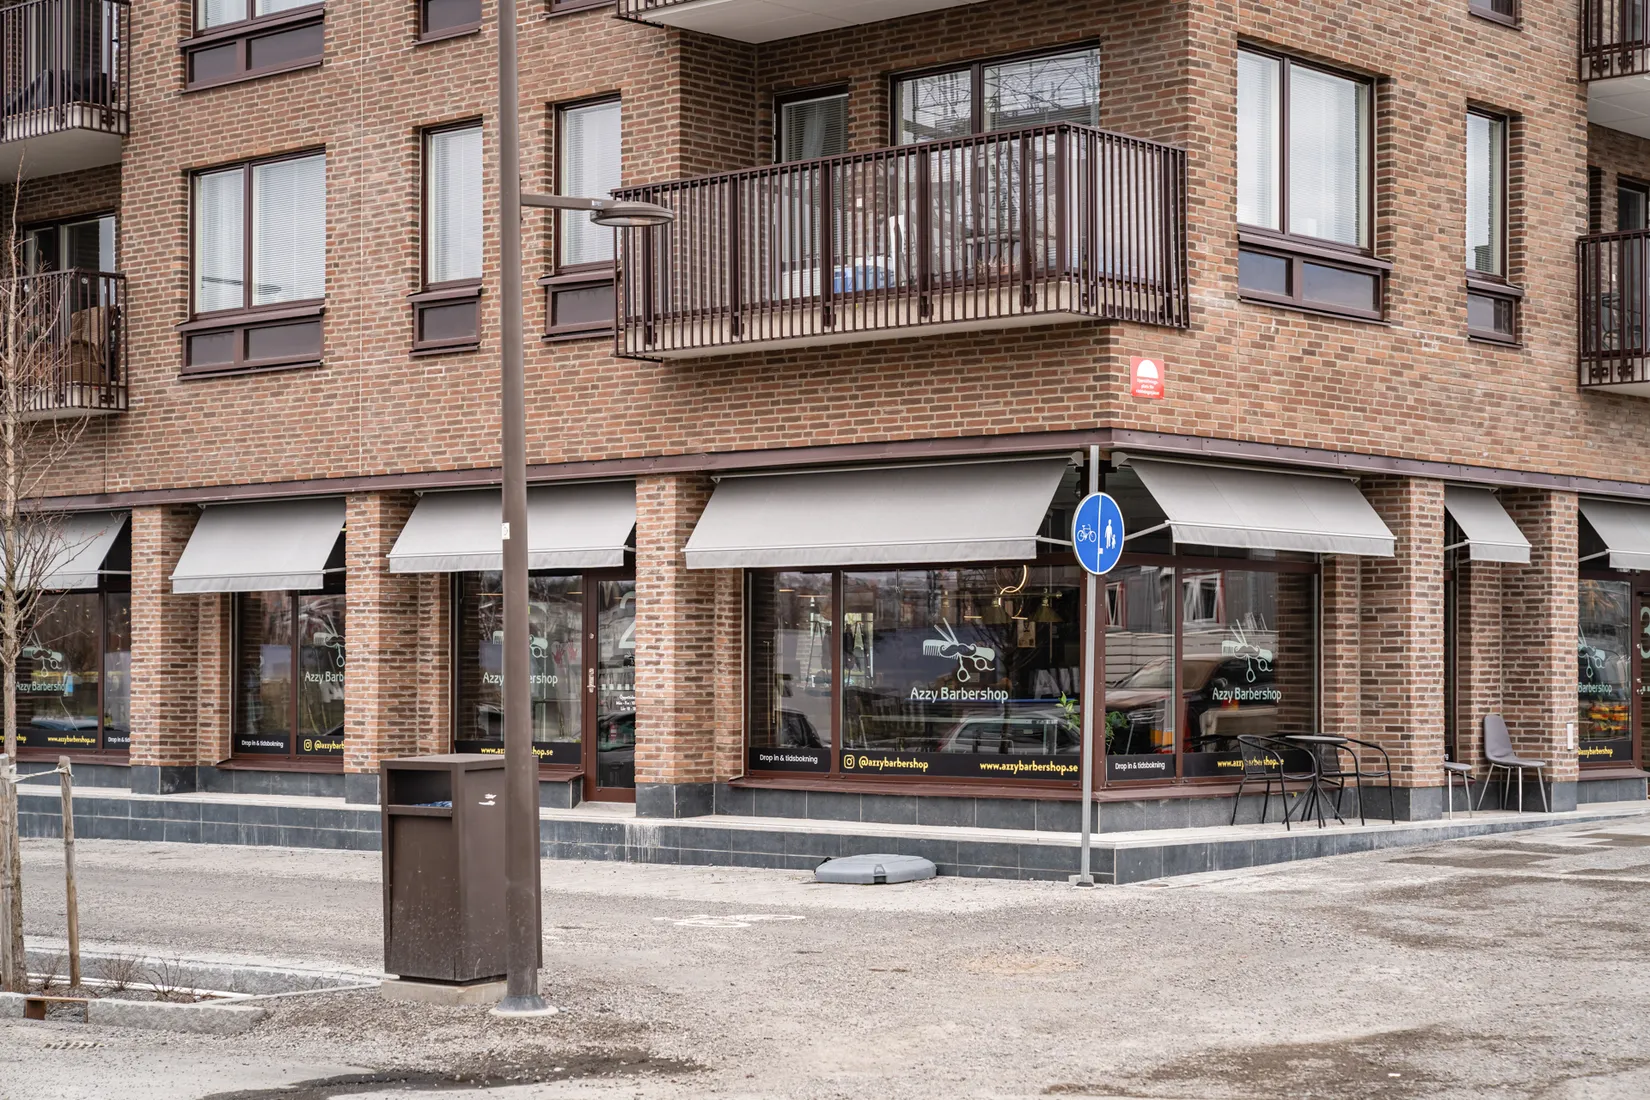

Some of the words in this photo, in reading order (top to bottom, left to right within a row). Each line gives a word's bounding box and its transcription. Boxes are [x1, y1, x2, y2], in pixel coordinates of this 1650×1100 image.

[305, 671, 324, 684] Azzy
[325, 671, 344, 682] Barb
[482, 672, 504, 686] Azzy
[32, 681, 65, 691] Barbersho
[910, 687, 938, 703] Azzy
[940, 687, 1009, 704] Barbershop
[1212, 687, 1233, 703] Azzy
[1234, 687, 1281, 703] Barbershop
[759, 754, 773, 762] Drop
[785, 755, 818, 764] tidsbokning
[858, 755, 928, 772] @azzybarbershop
[1115, 762, 1127, 771] Drop
[1137, 761, 1166, 770] tidsbokning
[979, 760, 1079, 775] www.azzybarbershop.se
